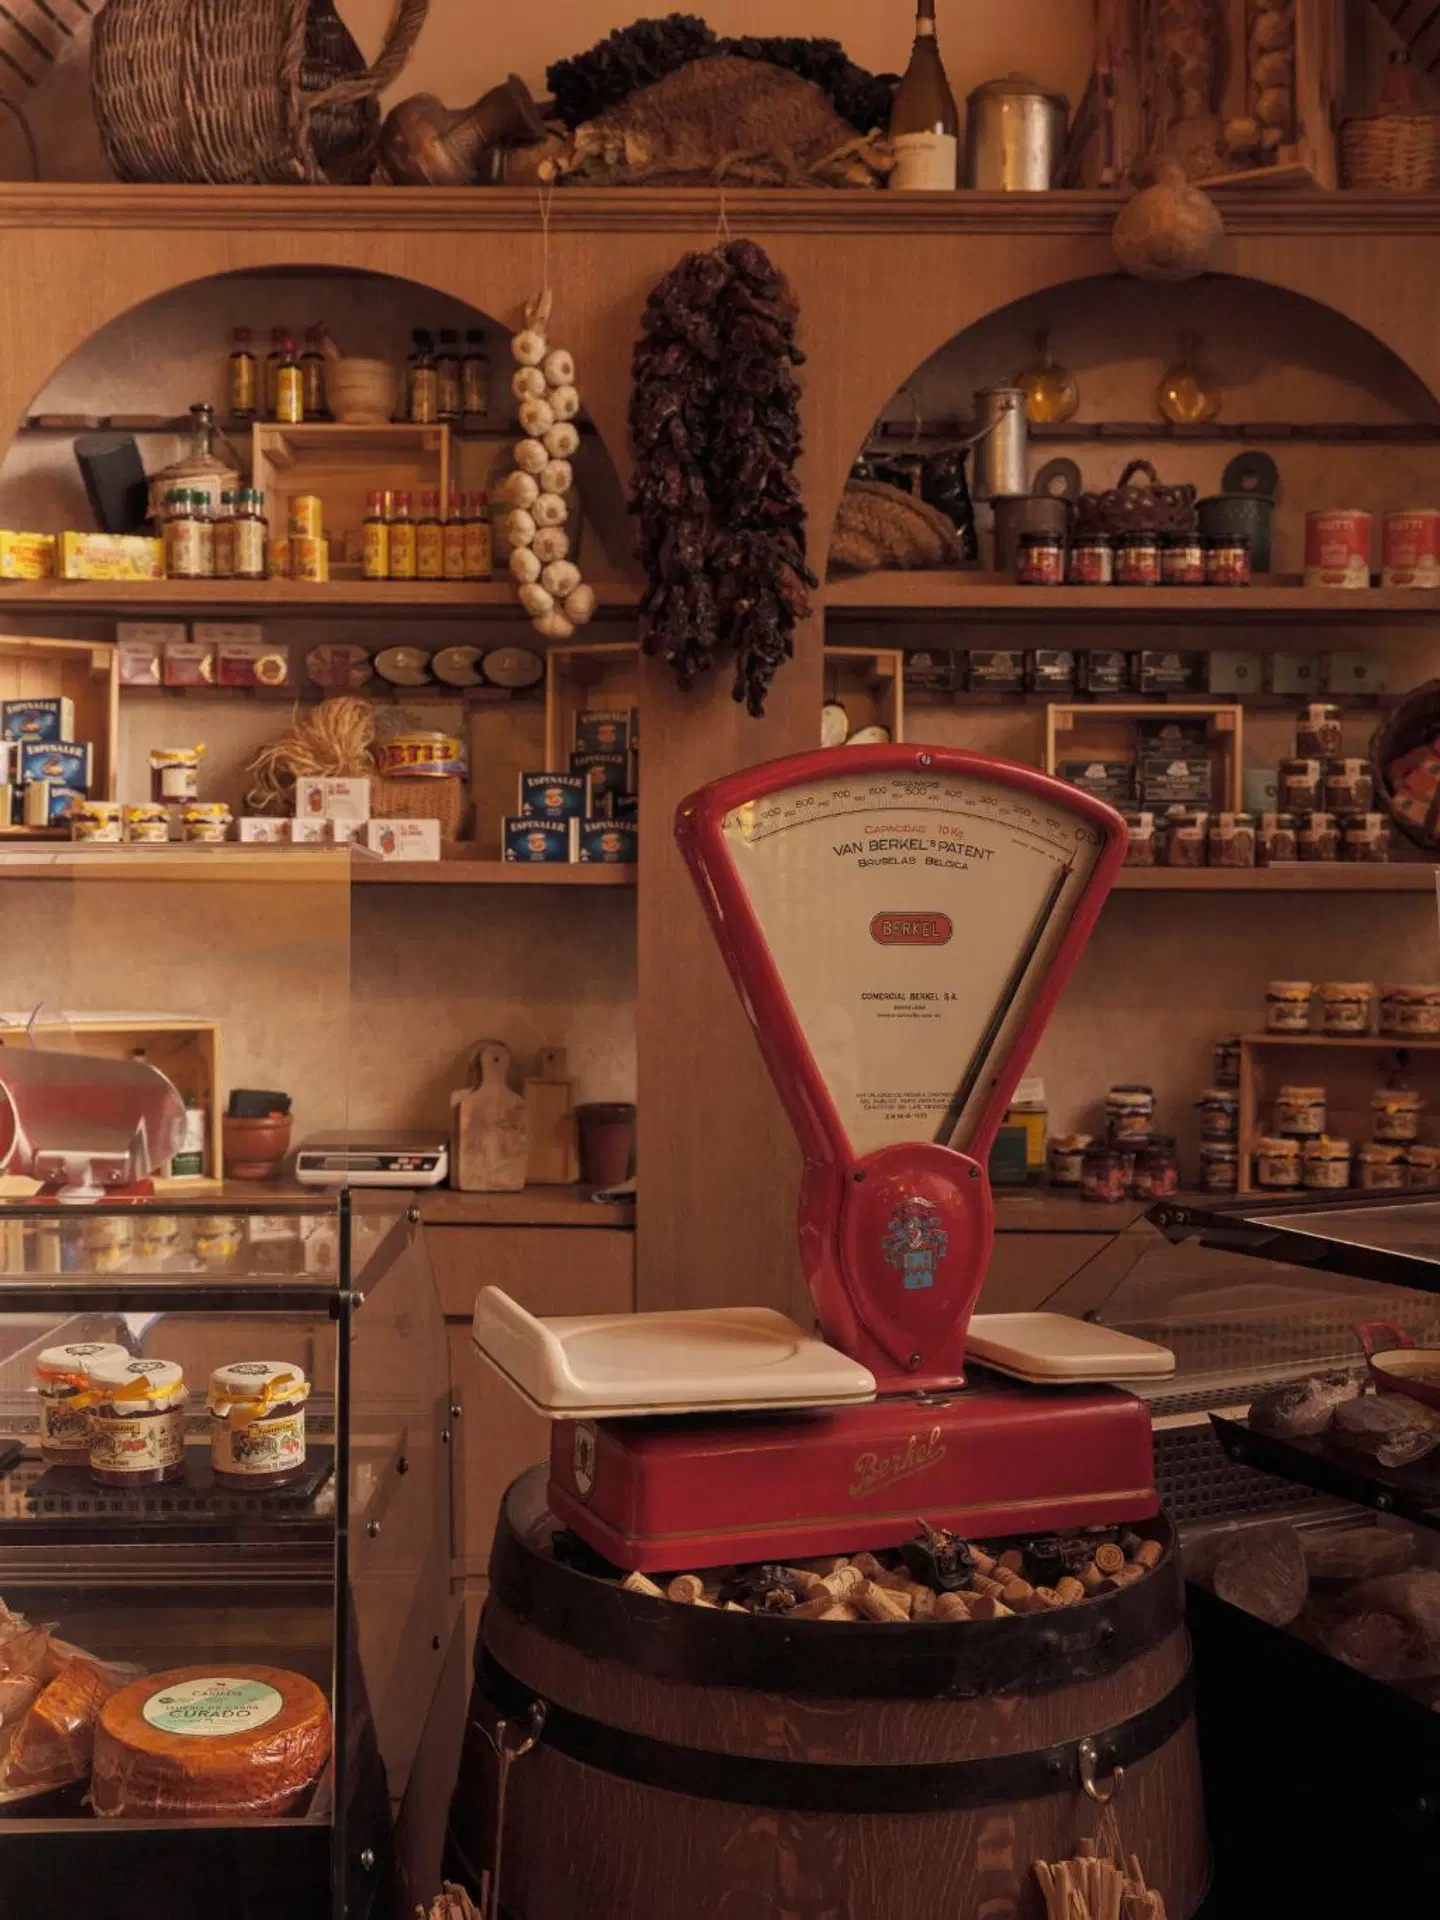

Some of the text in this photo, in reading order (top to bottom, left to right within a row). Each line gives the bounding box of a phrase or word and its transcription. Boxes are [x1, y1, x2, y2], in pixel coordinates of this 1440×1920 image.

[832, 842, 863, 857] VAN
[938, 842, 996, 861] PATENT
[883, 920, 941, 938] BERKEL
[861, 992, 907, 1001] COMERCIAL
[909, 992, 940, 1001] BERKEL
[849, 1426, 946, 1498] Berkel
[169, 1709, 251, 1718] CURADO
